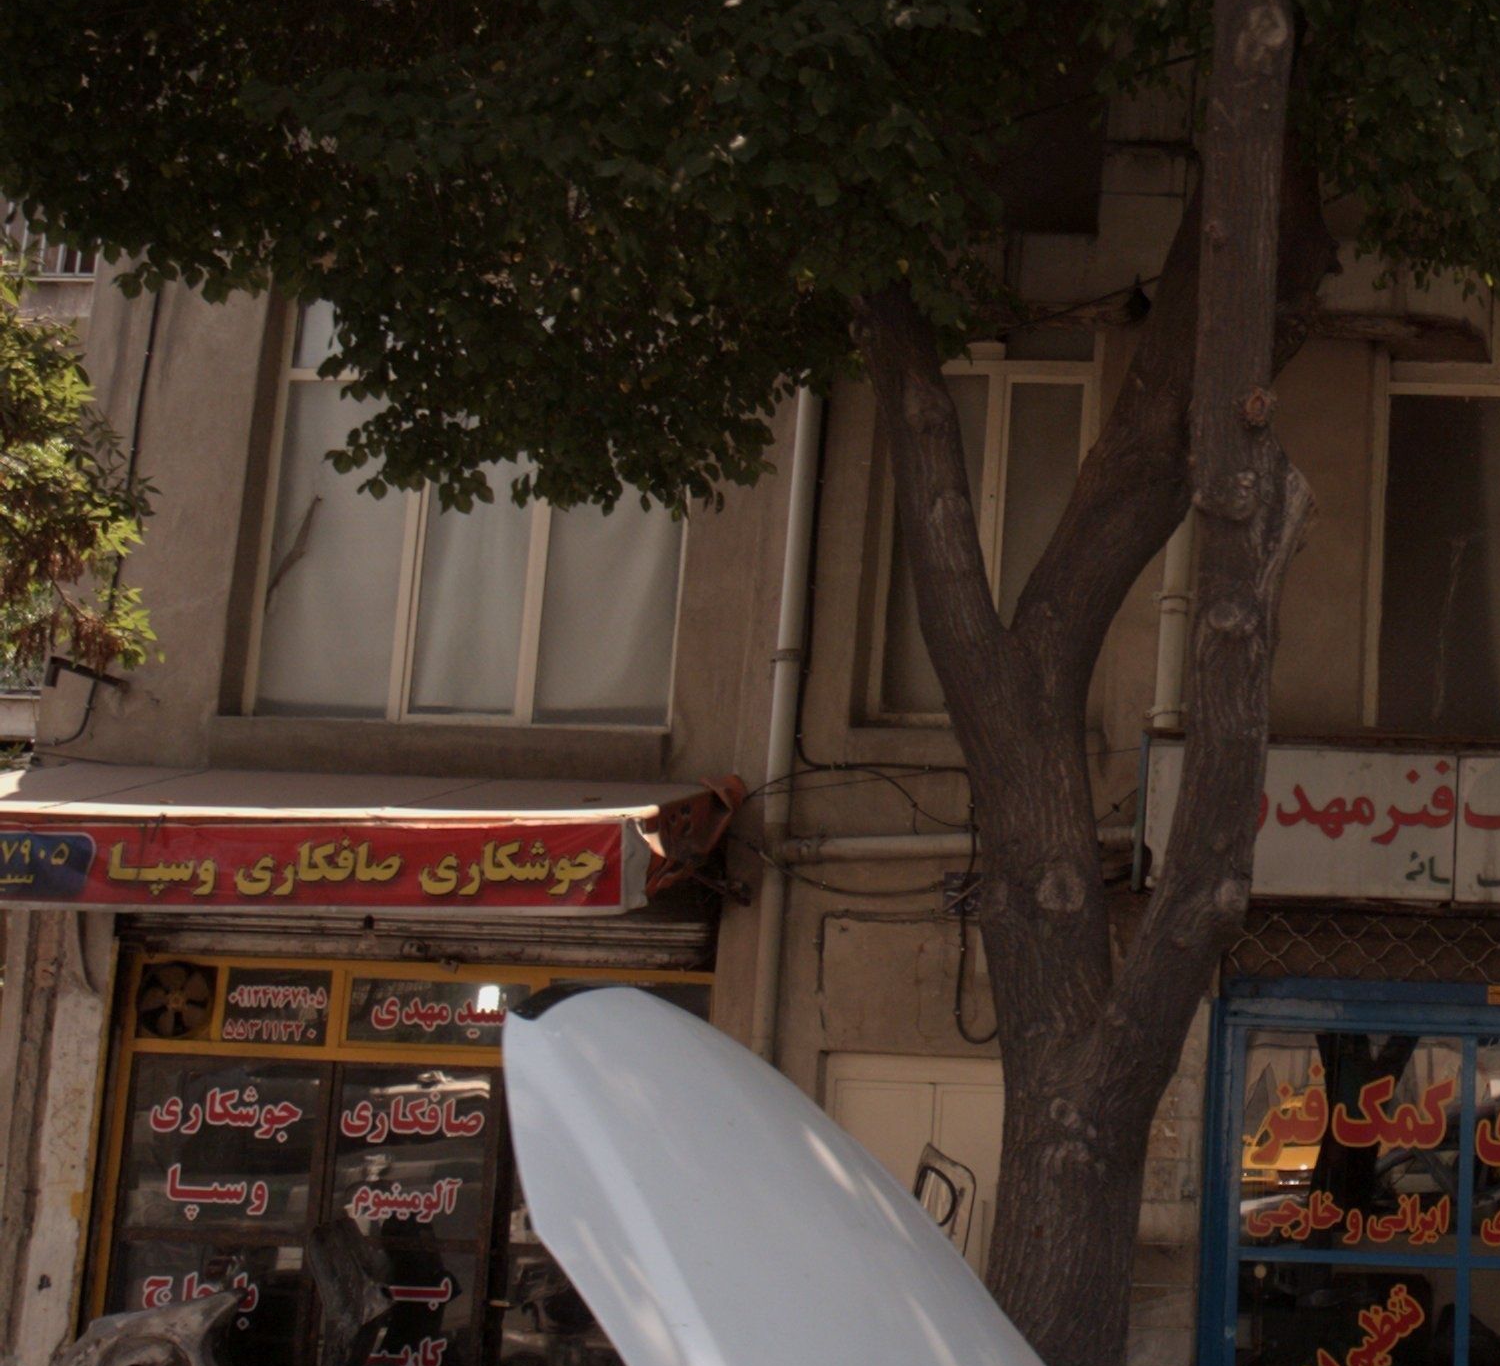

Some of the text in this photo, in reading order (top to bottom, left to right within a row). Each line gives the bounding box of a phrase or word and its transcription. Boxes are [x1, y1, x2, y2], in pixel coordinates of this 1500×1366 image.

[1256, 784, 1375, 839] مهد
[1371, 760, 1454, 845] فنر
[107, 836, 605, 896] جوشکاری صافکاری وسپا
[371, 997, 450, 1031] مهدی
[150, 1086, 301, 1143] جوشکاری
[341, 1091, 485, 1142] صافکاری
[1250, 1063, 1329, 1165] فنر
[1331, 1075, 1456, 1150] کمک
[352, 1178, 463, 1221] آلومینیوم
[1247, 1190, 1344, 1244] خارجی
[1342, 1207, 1363, 1244] و
[1366, 1193, 1450, 1244] ایرانی
